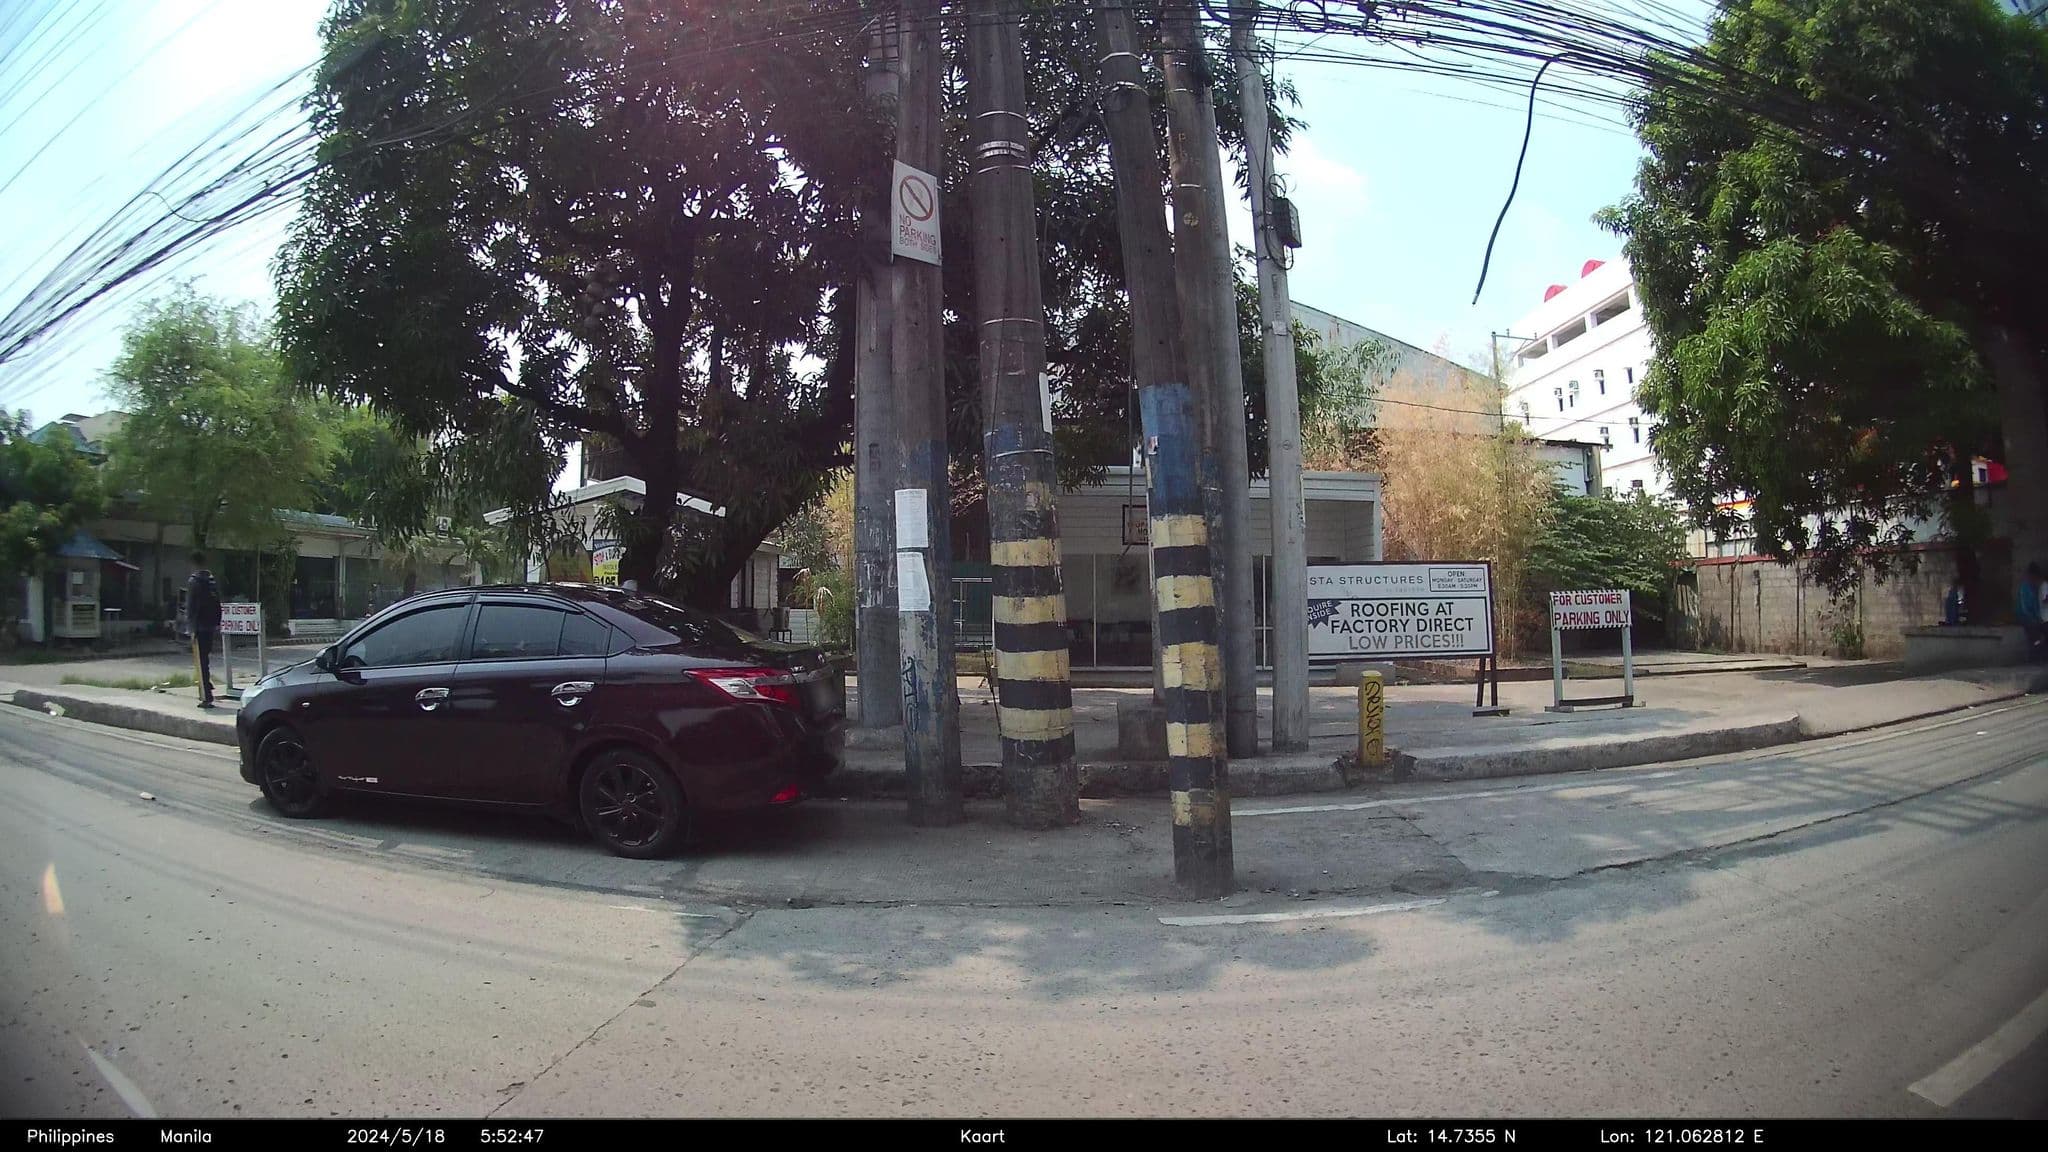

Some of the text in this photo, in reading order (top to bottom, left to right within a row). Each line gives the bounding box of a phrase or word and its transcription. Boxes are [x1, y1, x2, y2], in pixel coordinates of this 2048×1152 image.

[900, 213, 912, 227] NO
[900, 225, 937, 246] PARKING
[1309, 575, 1425, 586] STA STRUCTURES
[1553, 593, 1623, 606] FOR CUSTOMER
[1351, 602, 1454, 617] ROOFING AT
[1554, 610, 1629, 625] PARKING ONLY
[1331, 618, 1474, 634] FACTORY DIRECT
[1349, 633, 1464, 650] LOW PRICES!!!
